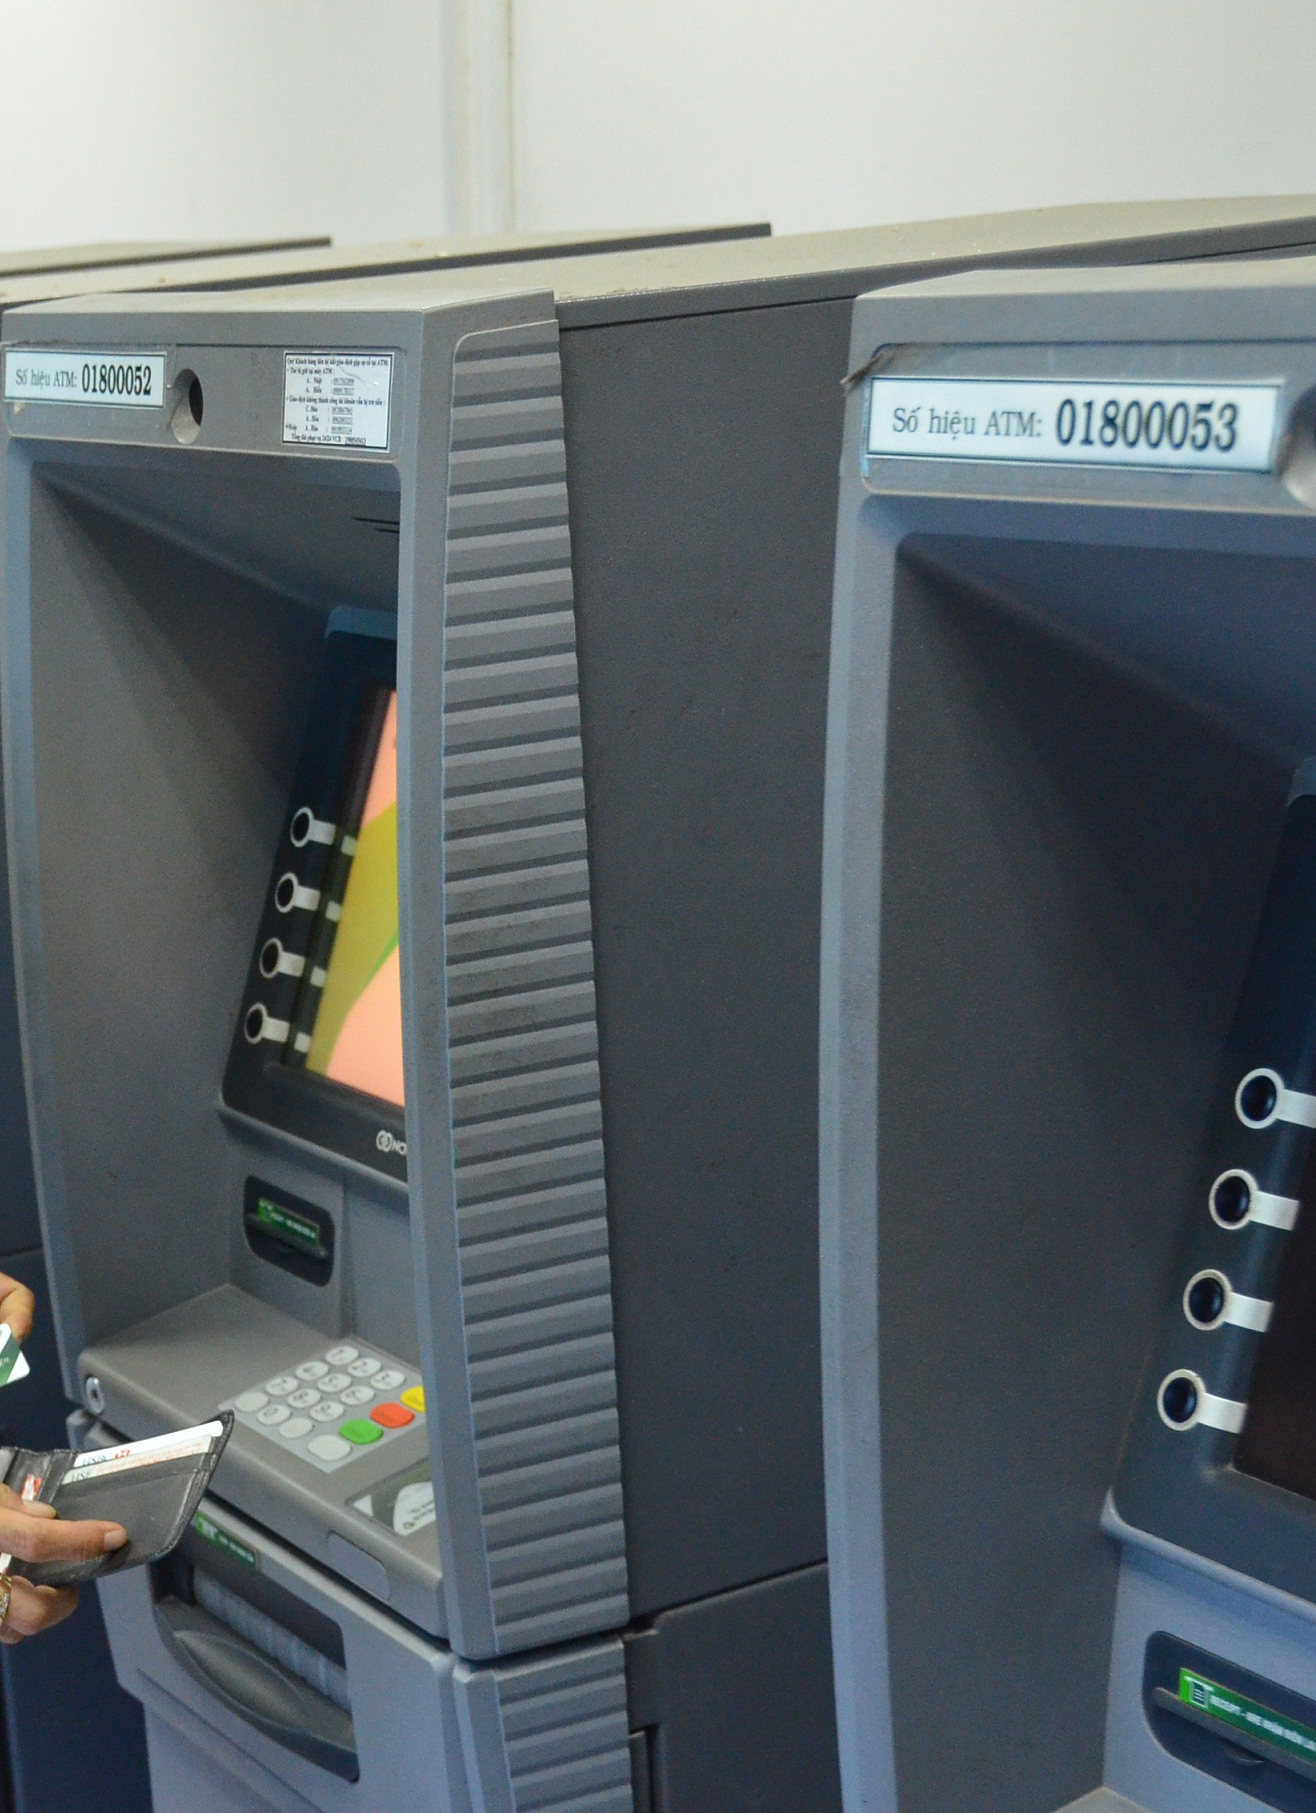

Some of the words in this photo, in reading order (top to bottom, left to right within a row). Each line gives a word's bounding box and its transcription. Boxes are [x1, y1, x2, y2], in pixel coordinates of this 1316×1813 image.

[15, 366, 28, 386] Số
[30, 367, 51, 390] hiệu
[53, 370, 78, 389] ATM:
[81, 363, 152, 396] 01800052
[892, 405, 921, 434] Số
[927, 407, 976, 441] hiệu
[984, 409, 1042, 438] ATM:
[1054, 398, 1240, 453] 01800053
